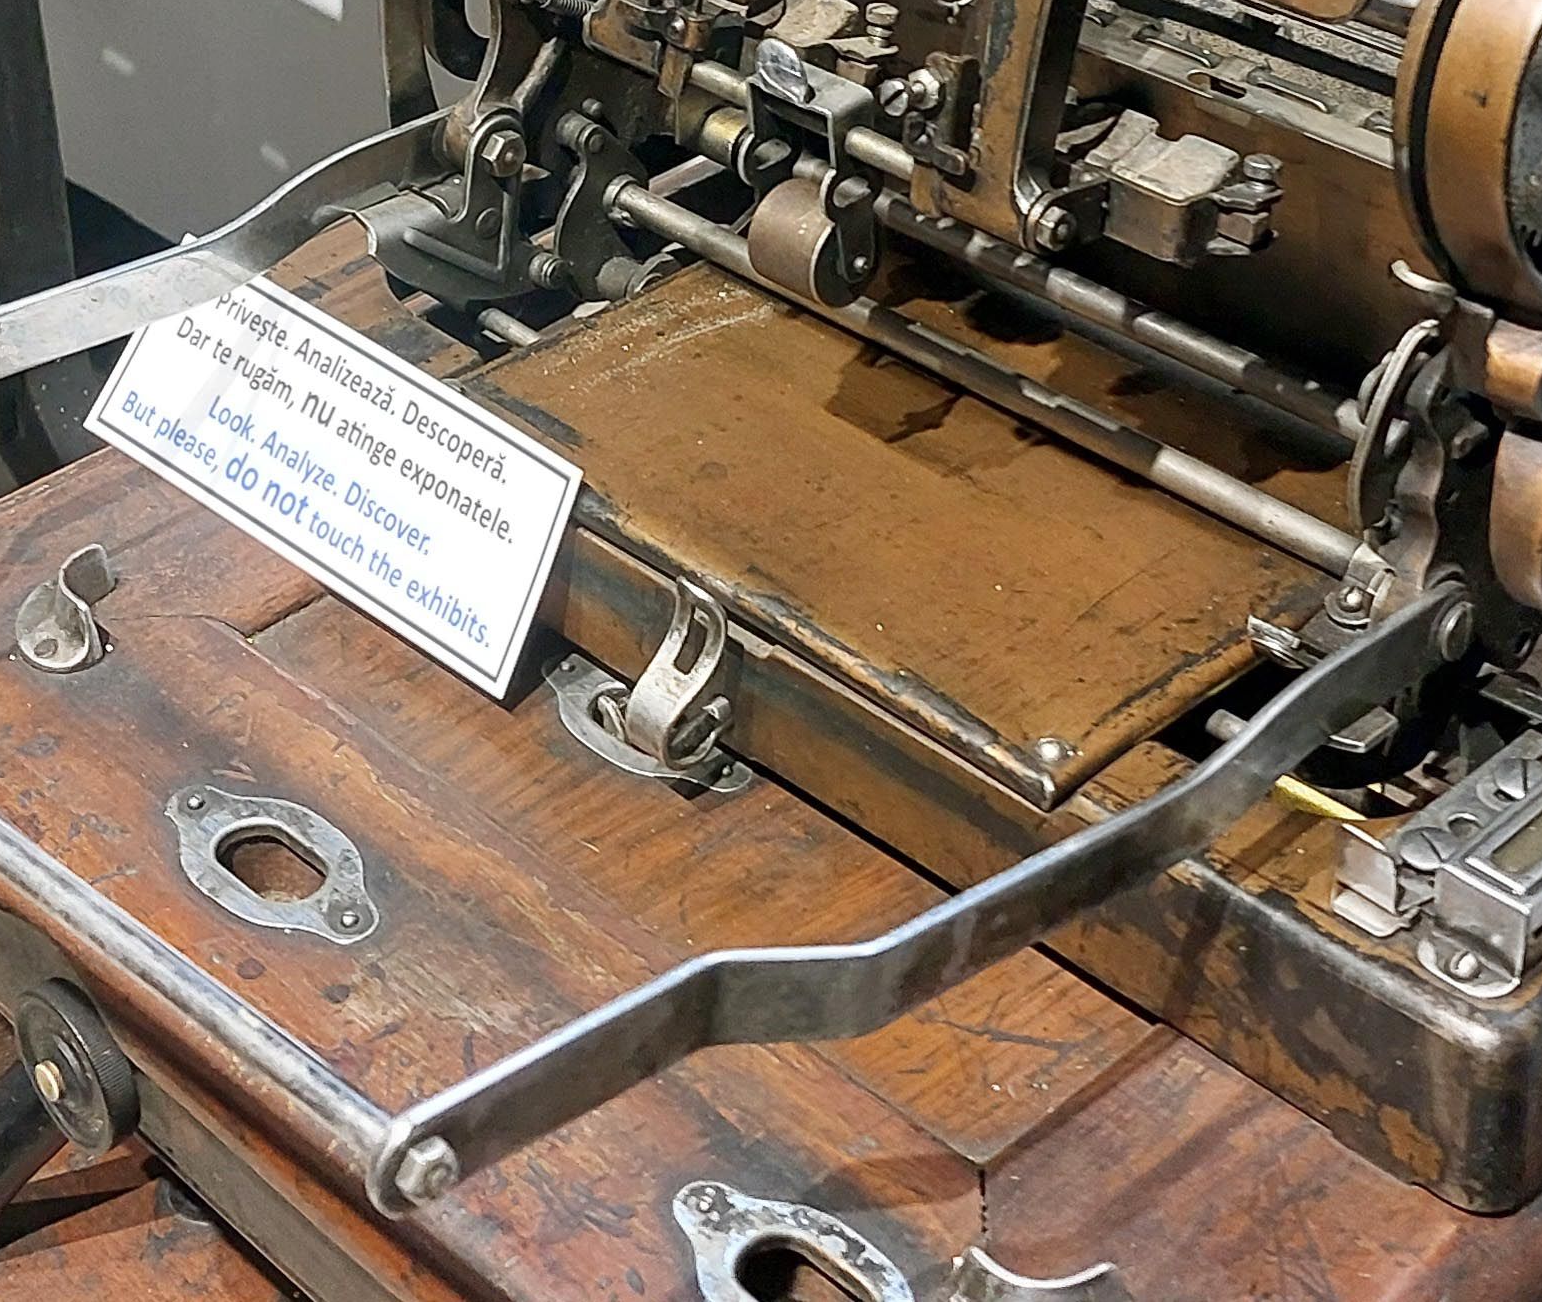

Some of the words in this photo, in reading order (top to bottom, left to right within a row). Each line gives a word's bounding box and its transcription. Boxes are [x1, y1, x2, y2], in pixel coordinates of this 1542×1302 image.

[176, 315, 211, 351] Dar
[212, 338, 233, 365] te
[232, 354, 296, 410] rugăm,
[300, 391, 337, 428] nu
[336, 418, 397, 467] atinge
[399, 458, 514, 545] exponatele.
[208, 395, 256, 444] Look.
[260, 430, 338, 497] Analyze.
[344, 481, 430, 556] Discover.
[294, 338, 396, 416] Analizează.
[401, 400, 508, 484] Descoperă.
[120, 390, 157, 427] But
[153, 418, 219, 474] please,
[225, 452, 260, 492] do
[261, 479, 310, 525] not
[308, 510, 364, 564] touch
[367, 549, 403, 588] the
[405, 577, 492, 649] exhibits.
